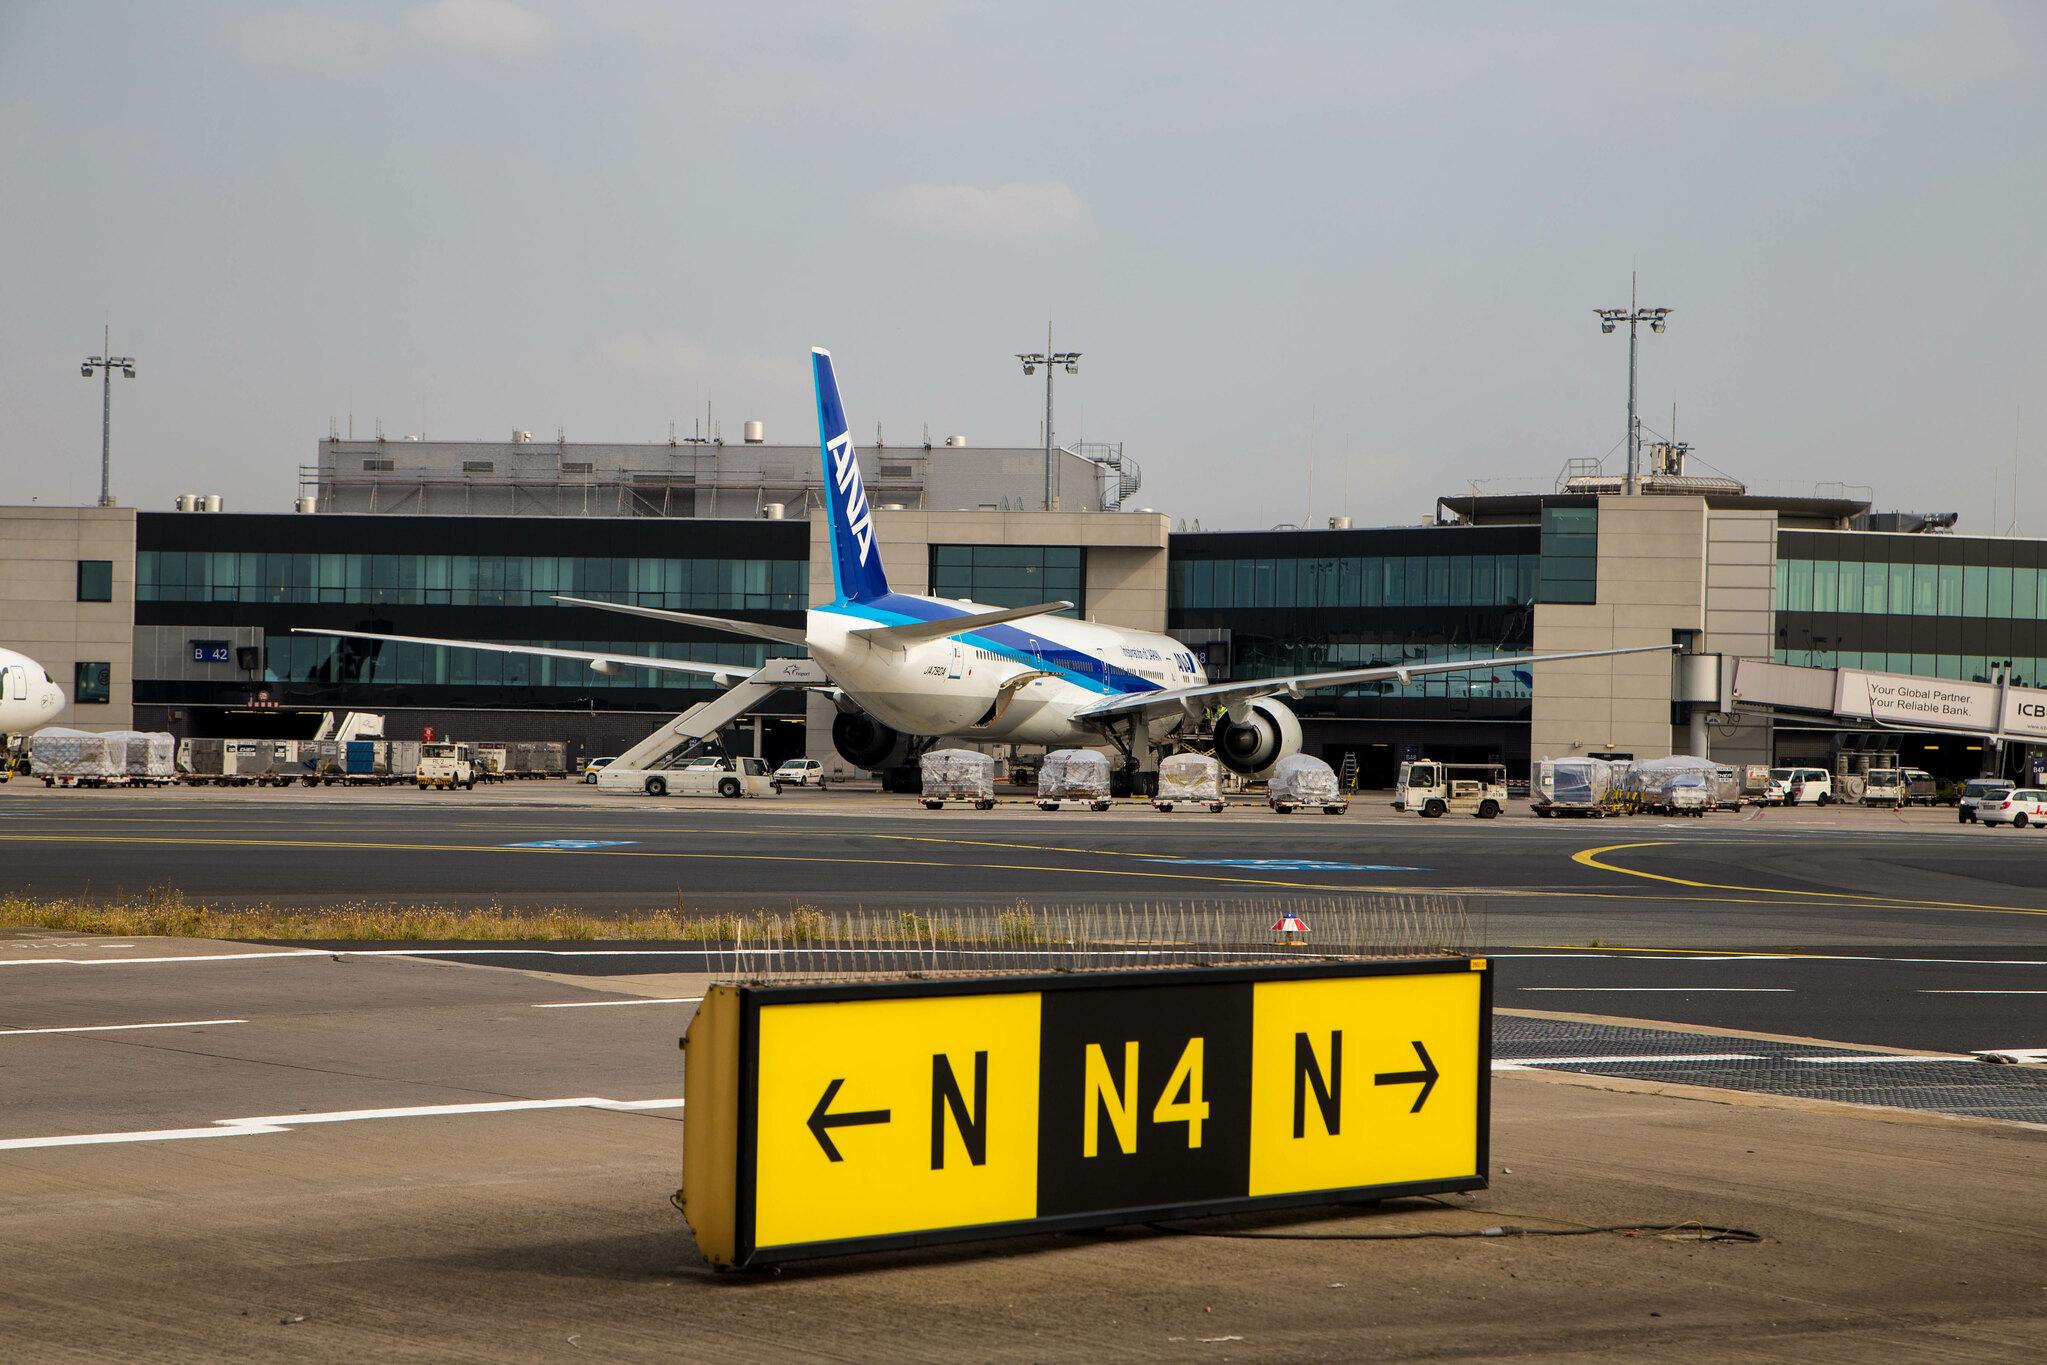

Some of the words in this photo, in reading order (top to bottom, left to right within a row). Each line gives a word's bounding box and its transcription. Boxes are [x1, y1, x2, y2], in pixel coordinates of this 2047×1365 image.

[827, 430, 873, 568] ANA
[195, 649, 203, 660] B
[212, 649, 228, 660] 42
[1195, 651, 1206, 664] 8
[1871, 683, 1895, 695] Your
[1897, 686, 1931, 699] Global
[1933, 690, 1973, 704] Partner.
[1869, 696, 1894, 708] Your
[1897, 699, 1939, 713] Reliable
[1942, 704, 1972, 717] Bank.
[930, 1050, 988, 1171] N
[1082, 1036, 1210, 1158] N4
[1293, 1029, 1343, 1139] N
